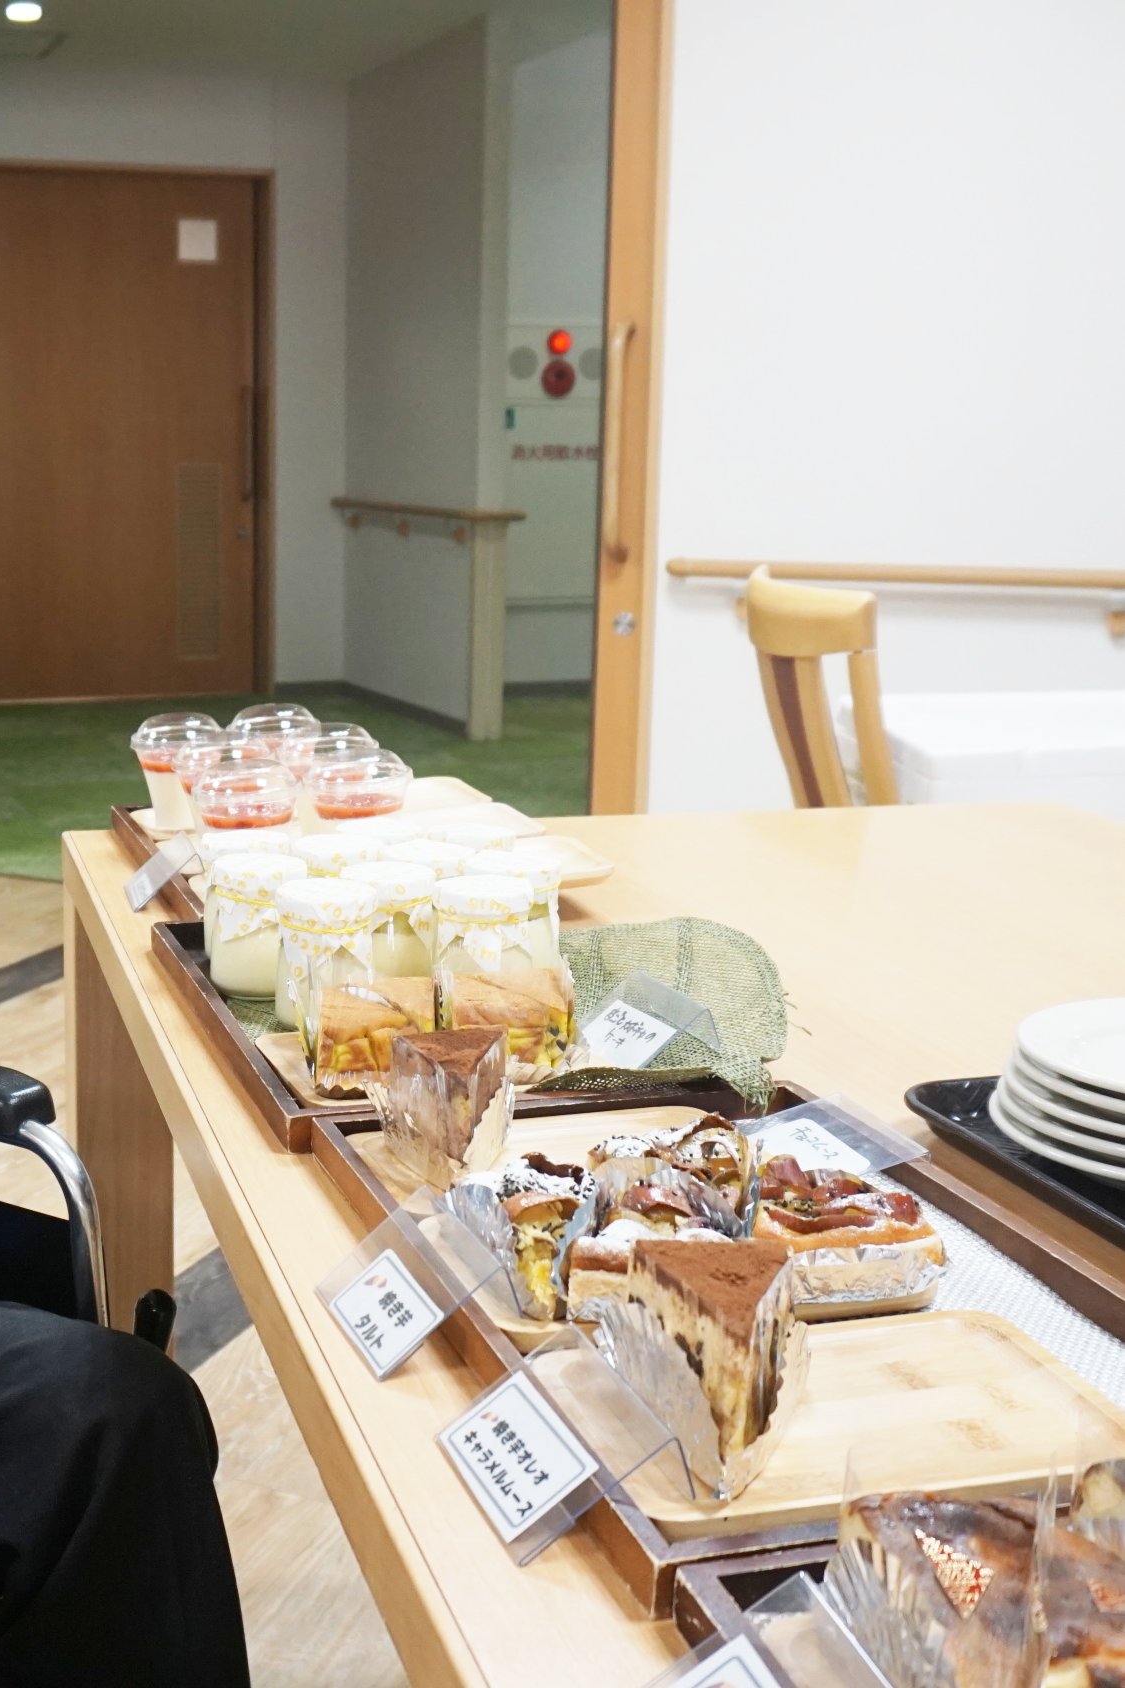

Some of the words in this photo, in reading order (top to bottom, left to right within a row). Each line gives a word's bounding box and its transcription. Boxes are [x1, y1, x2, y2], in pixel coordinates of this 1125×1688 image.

[354, 1313, 385, 1349] タルト
[378, 1291, 413, 1328] 焼き芋
[464, 1431, 533, 1517] キャラメルムース
[492, 1420, 550, 1485] 焼き芋オレオ
